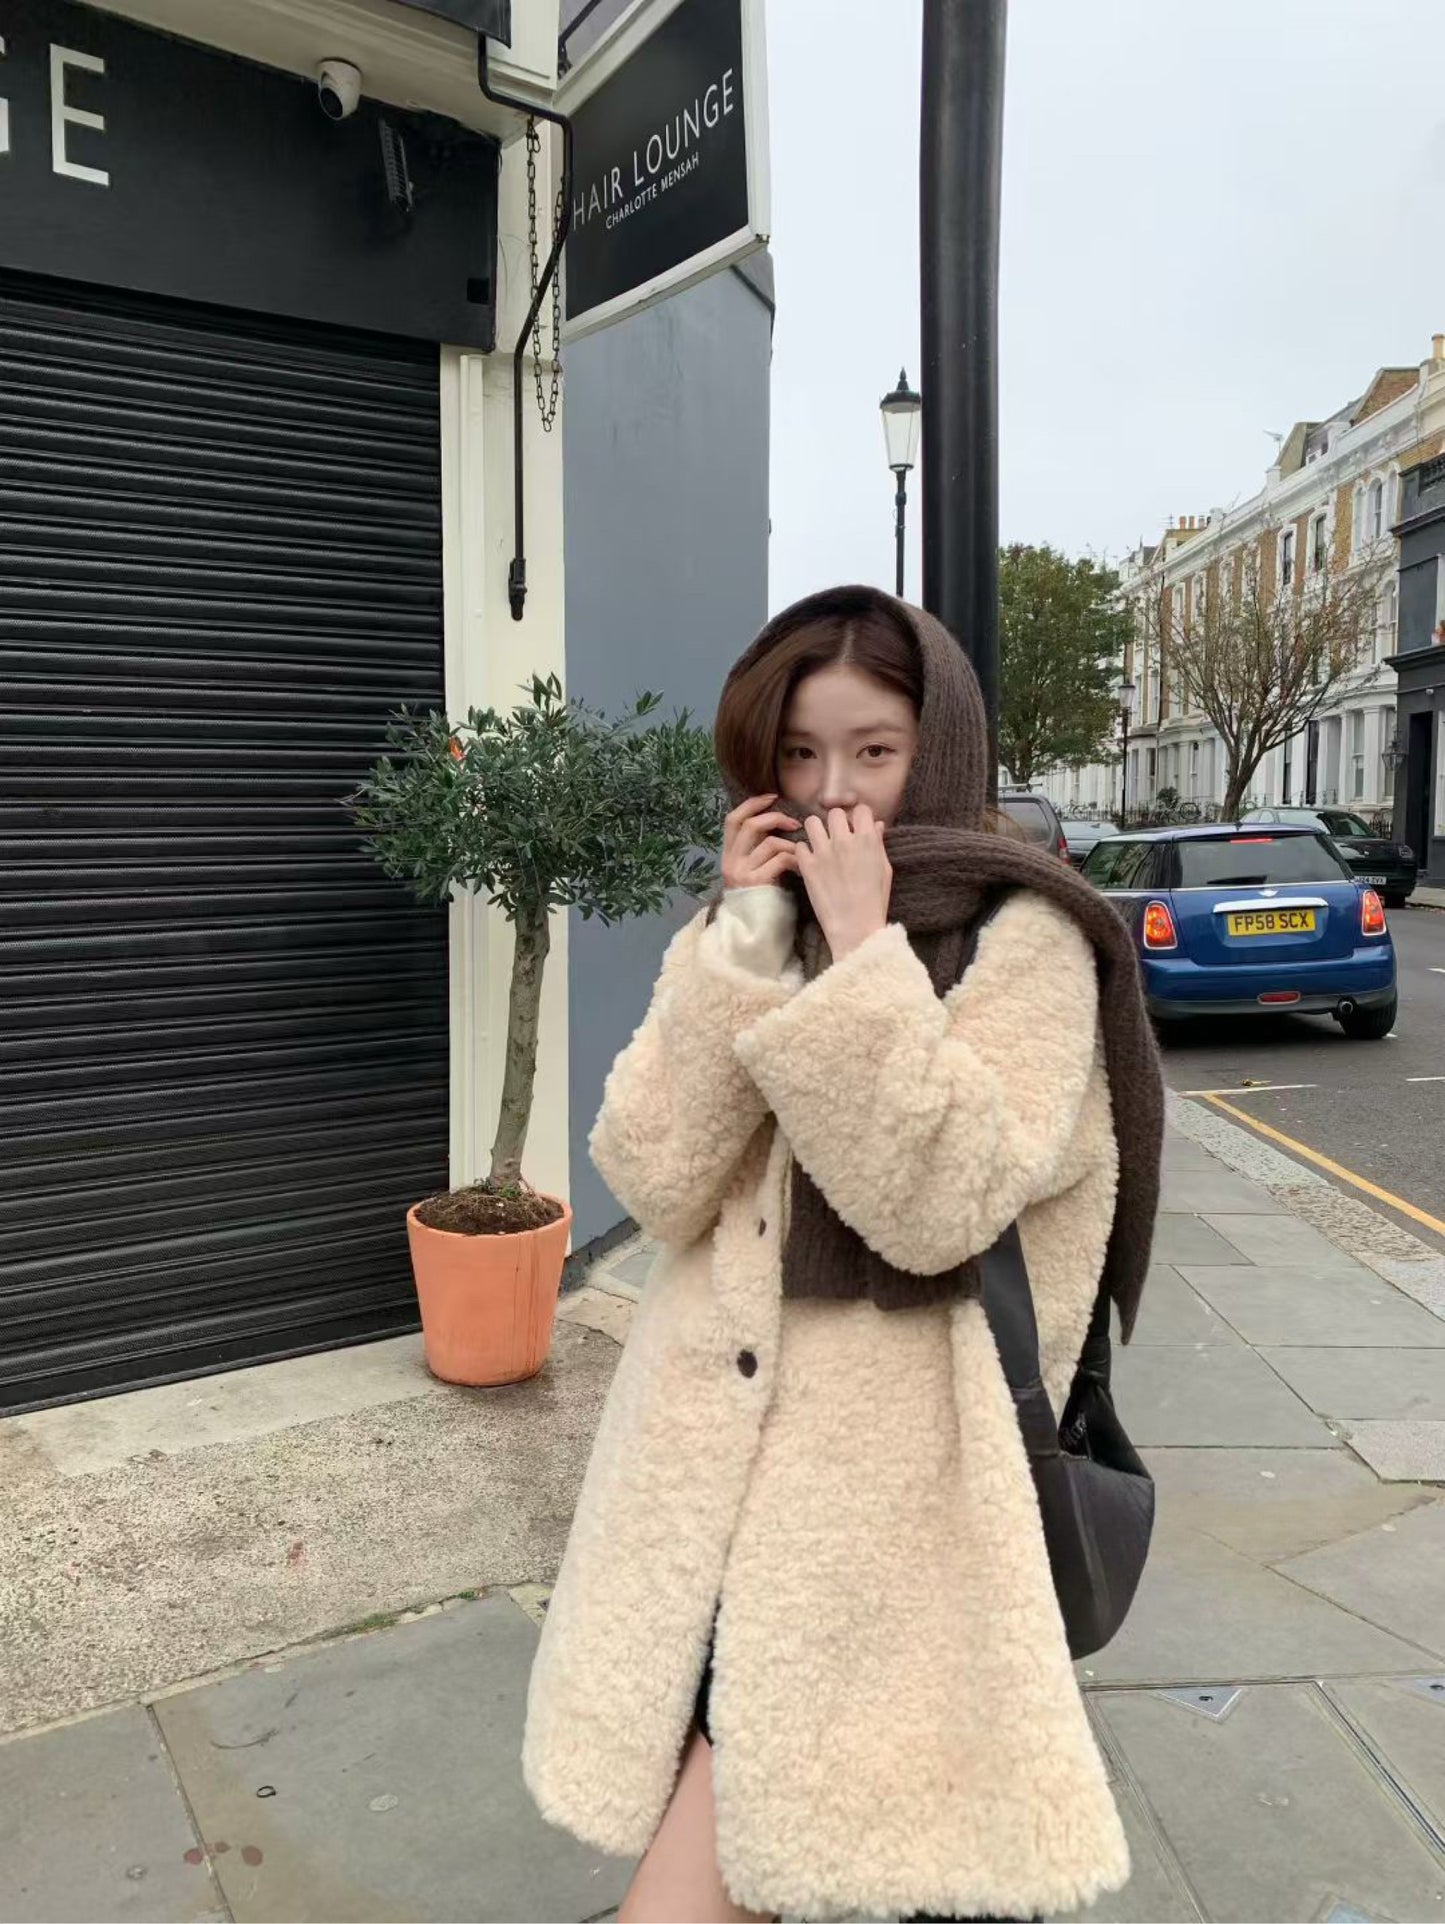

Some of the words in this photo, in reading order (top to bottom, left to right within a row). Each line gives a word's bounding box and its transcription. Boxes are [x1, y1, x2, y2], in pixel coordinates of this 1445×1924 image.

[0, 35, 109, 187] E
[572, 166, 623, 231] HAIR
[633, 67, 733, 187] LOUNGE
[605, 183, 658, 229] CHARLOTTE
[661, 152, 700, 192] MENSAH
[1234, 914, 1275, 932] FP58
[1279, 912, 1309, 929] SCX
